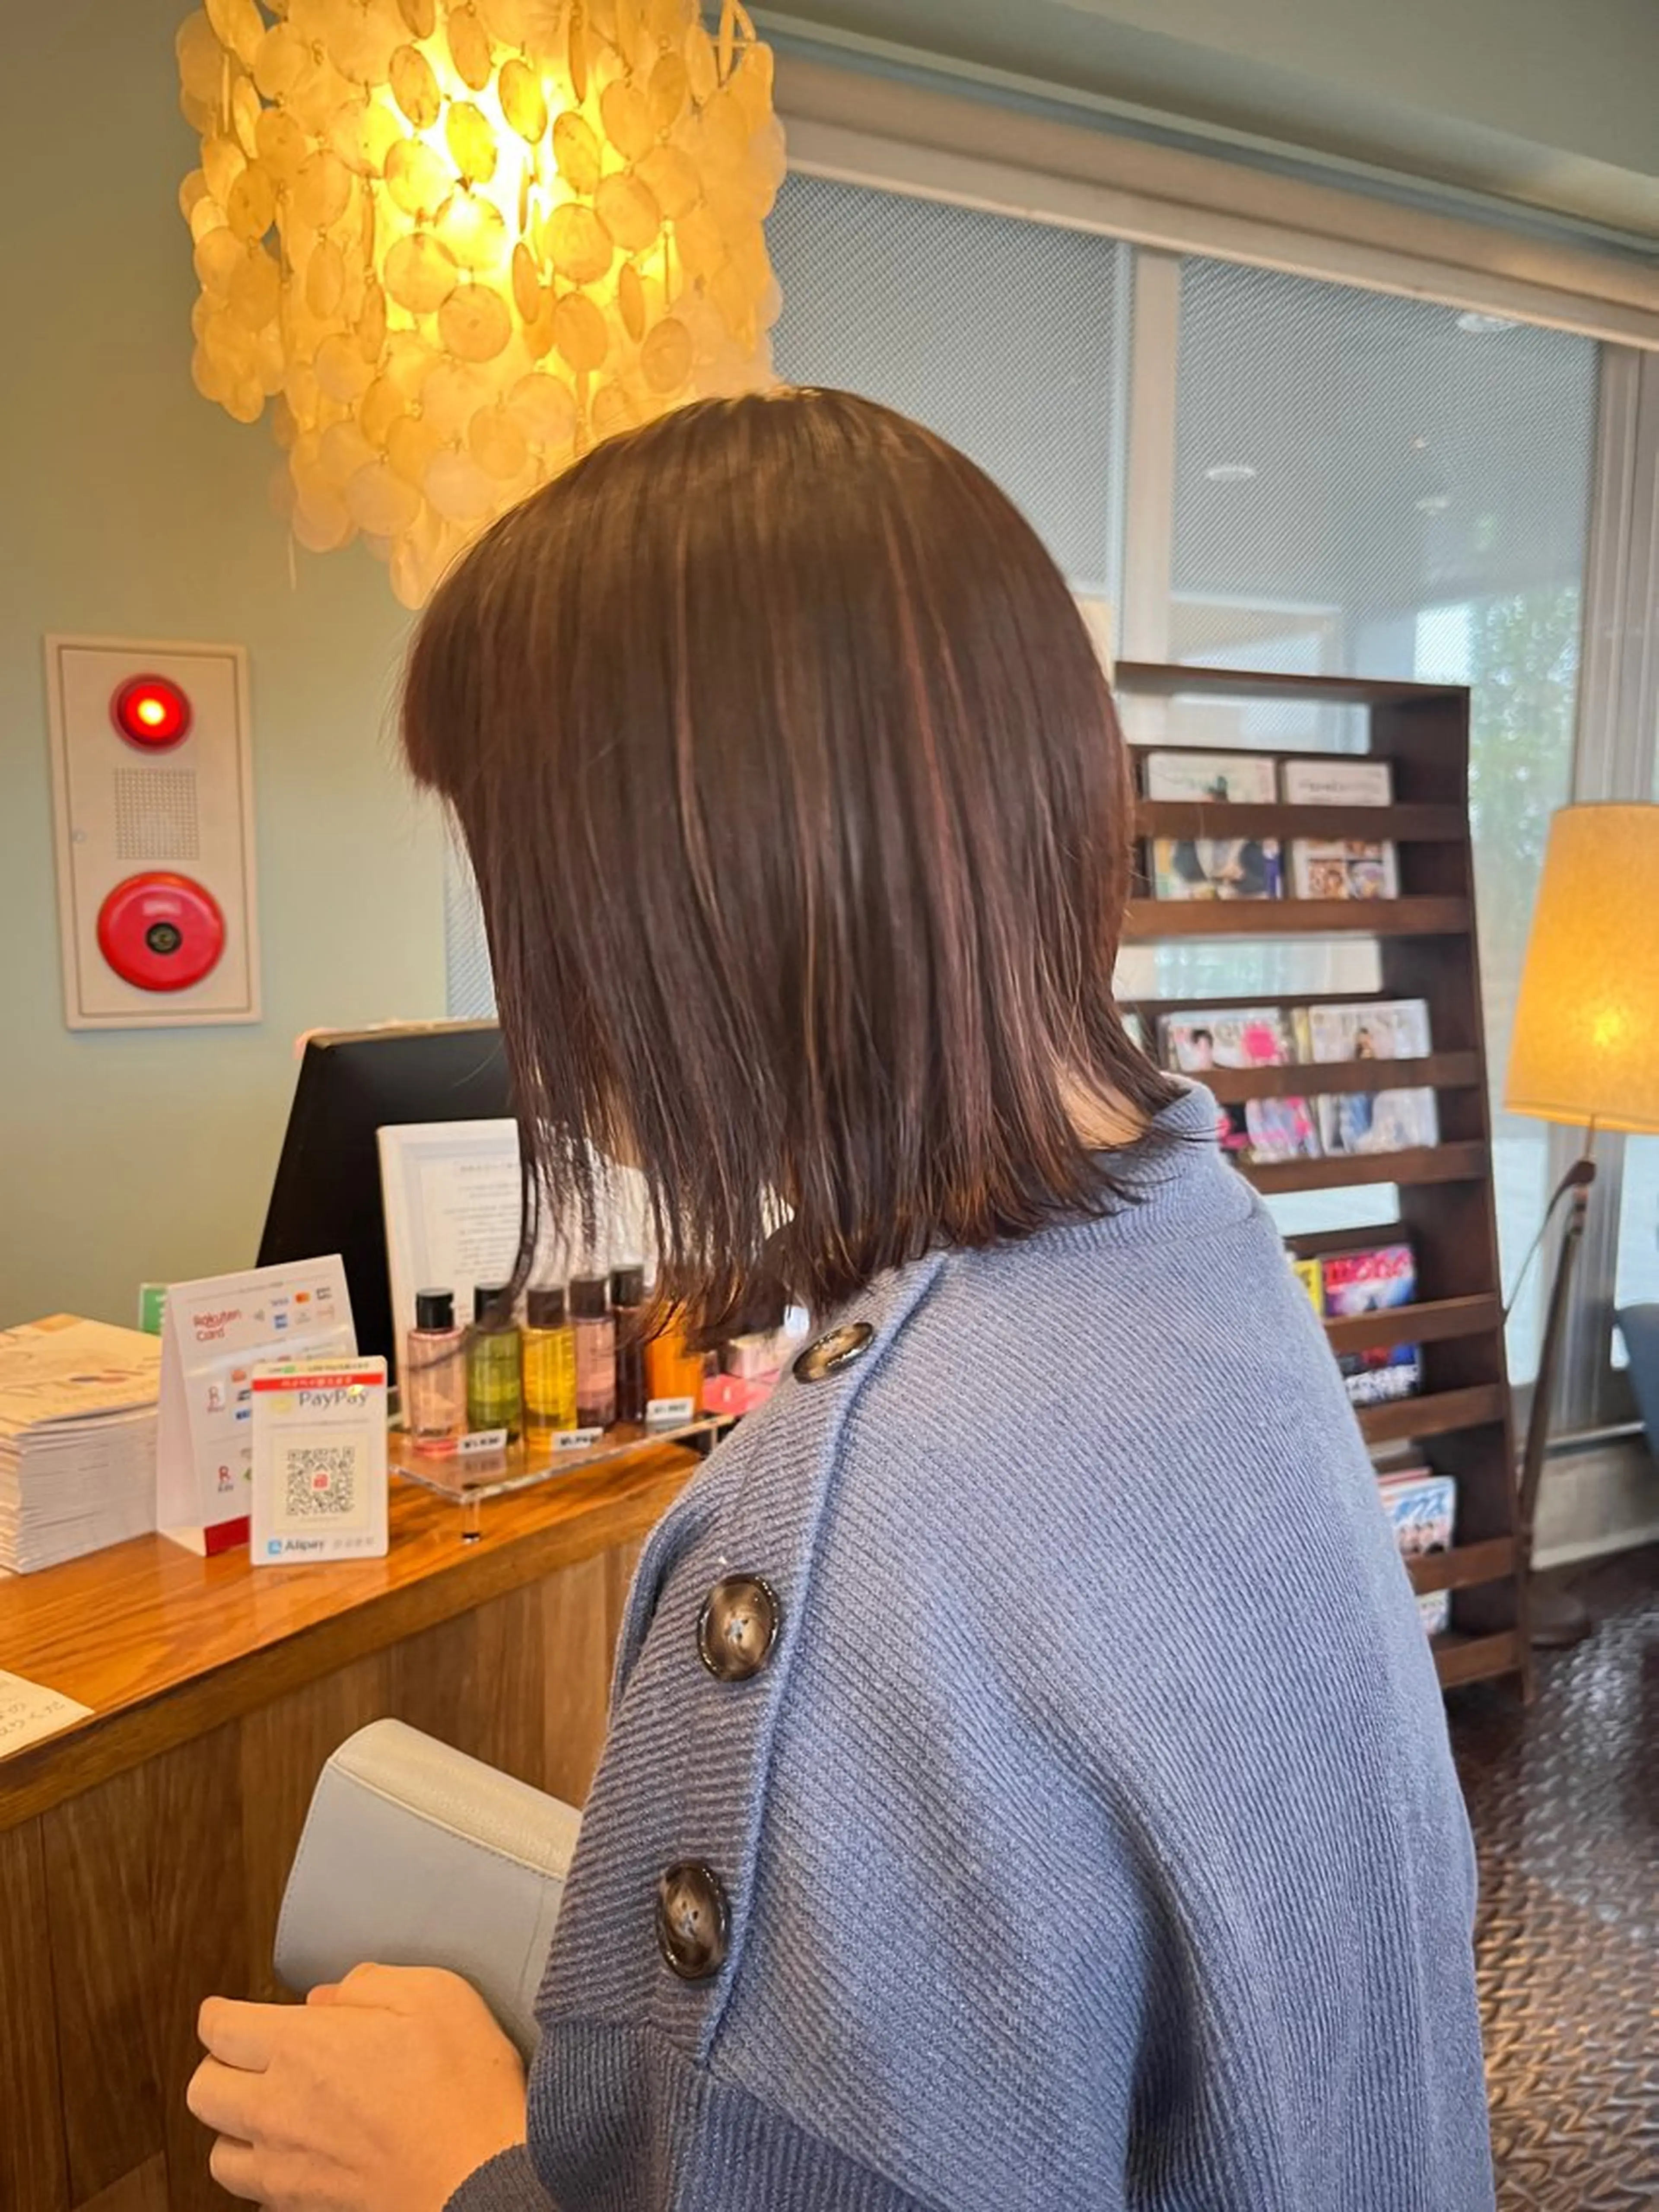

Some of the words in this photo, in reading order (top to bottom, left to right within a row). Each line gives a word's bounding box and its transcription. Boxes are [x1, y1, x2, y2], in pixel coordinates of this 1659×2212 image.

[193, 1309, 242, 1328] Rakuten
[196, 1328, 226, 1341] Card
[299, 1388, 369, 1410] PayPay
[285, 1539, 325, 1551] Alipay
